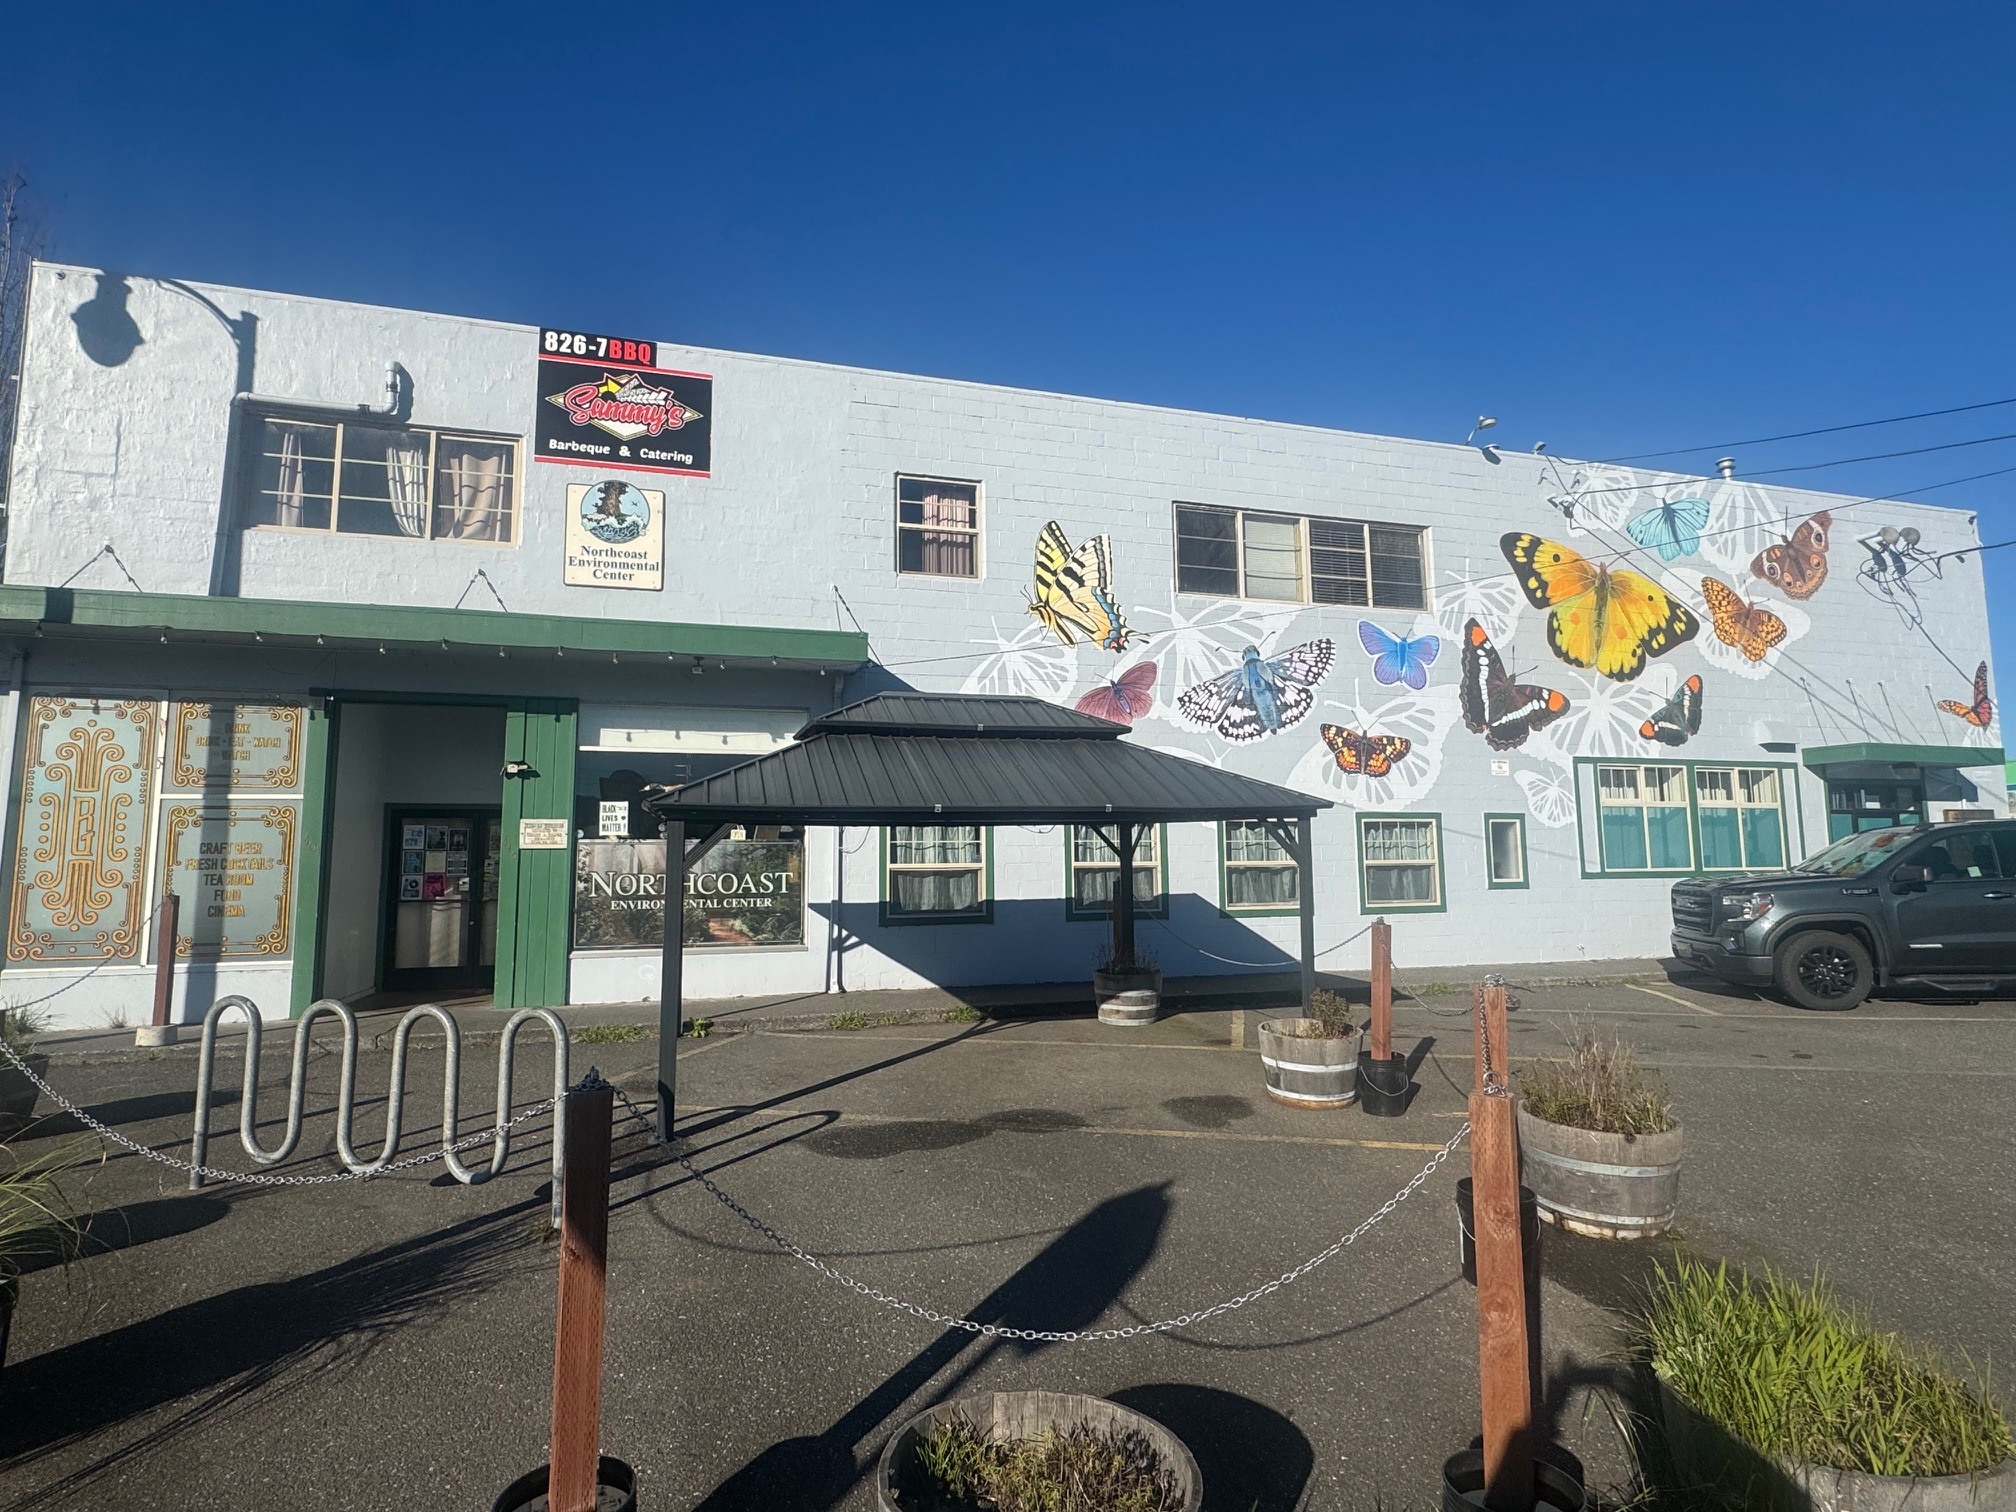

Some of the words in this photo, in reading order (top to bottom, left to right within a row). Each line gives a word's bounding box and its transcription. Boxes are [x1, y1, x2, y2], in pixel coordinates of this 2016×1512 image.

[545, 331, 651, 364] 826-7BBQ
[565, 386, 684, 434] Sammy's
[549, 438, 610, 455] Barbeque
[619, 446, 631, 457] &
[640, 448, 693, 465] Catering
[580, 545, 648, 560] Northcoast
[568, 556, 660, 572] Environmental
[593, 569, 635, 581] Center
[253, 737, 281, 748] WATCH
[602, 804, 616, 813] BLACK
[601, 823, 621, 832] MATTER
[200, 842, 234, 855] CRAFT
[235, 842, 262, 855] BEER
[185, 858, 219, 871] FRESH
[221, 858, 274, 871] COCKTAILS
[204, 873, 223, 886] TEA
[226, 874, 254, 886] ROOM
[214, 889, 241, 901] FOOD
[723, 897, 772, 908] CENTER
[207, 905, 245, 918] CINEMA
